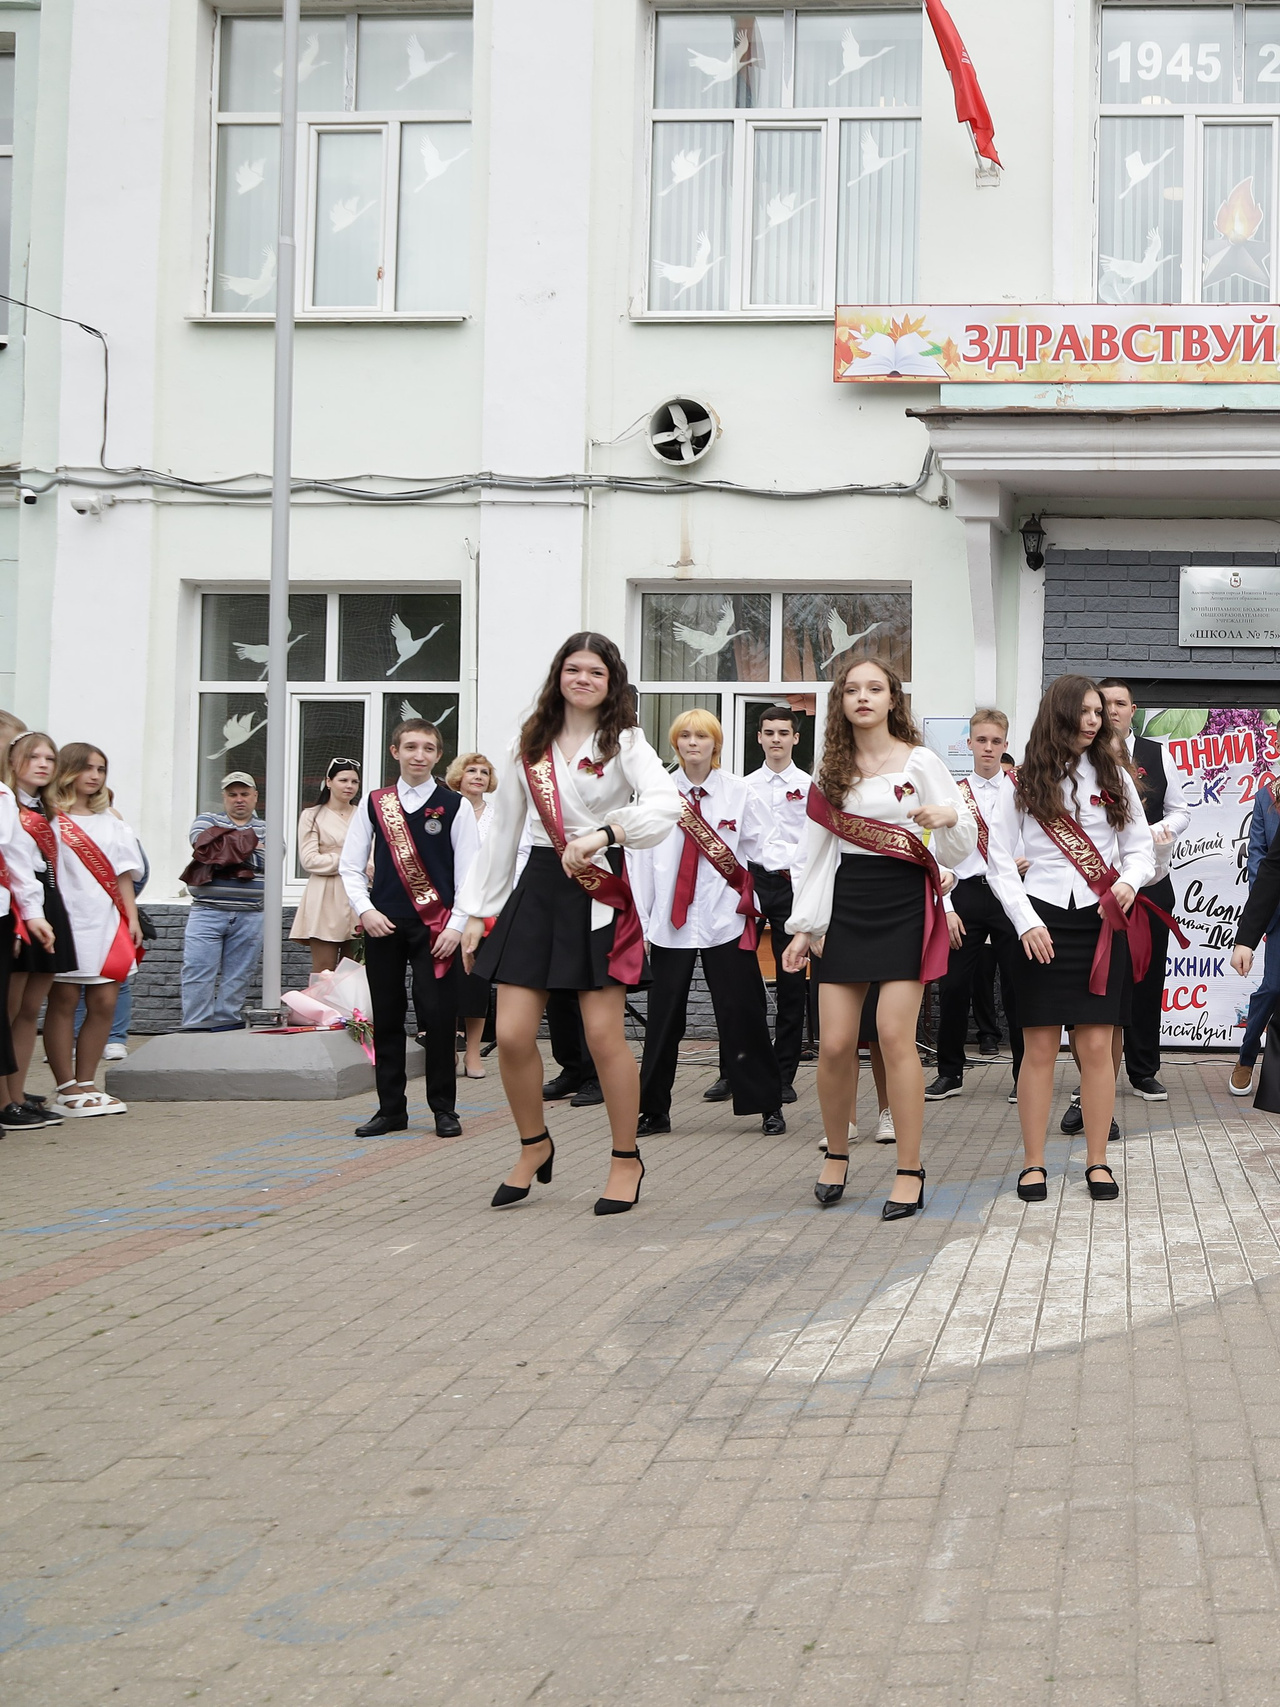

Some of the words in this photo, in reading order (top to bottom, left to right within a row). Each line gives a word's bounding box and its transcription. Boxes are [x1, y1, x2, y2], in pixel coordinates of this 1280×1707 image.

[1107, 41, 1222, 83] 1945
[1189, 629, 1243, 639] «ШКОЛА
[1246, 630, 1261, 640] №
[1263, 630, 1280, 640] 75»
[1068, 842, 1108, 881] 2025
